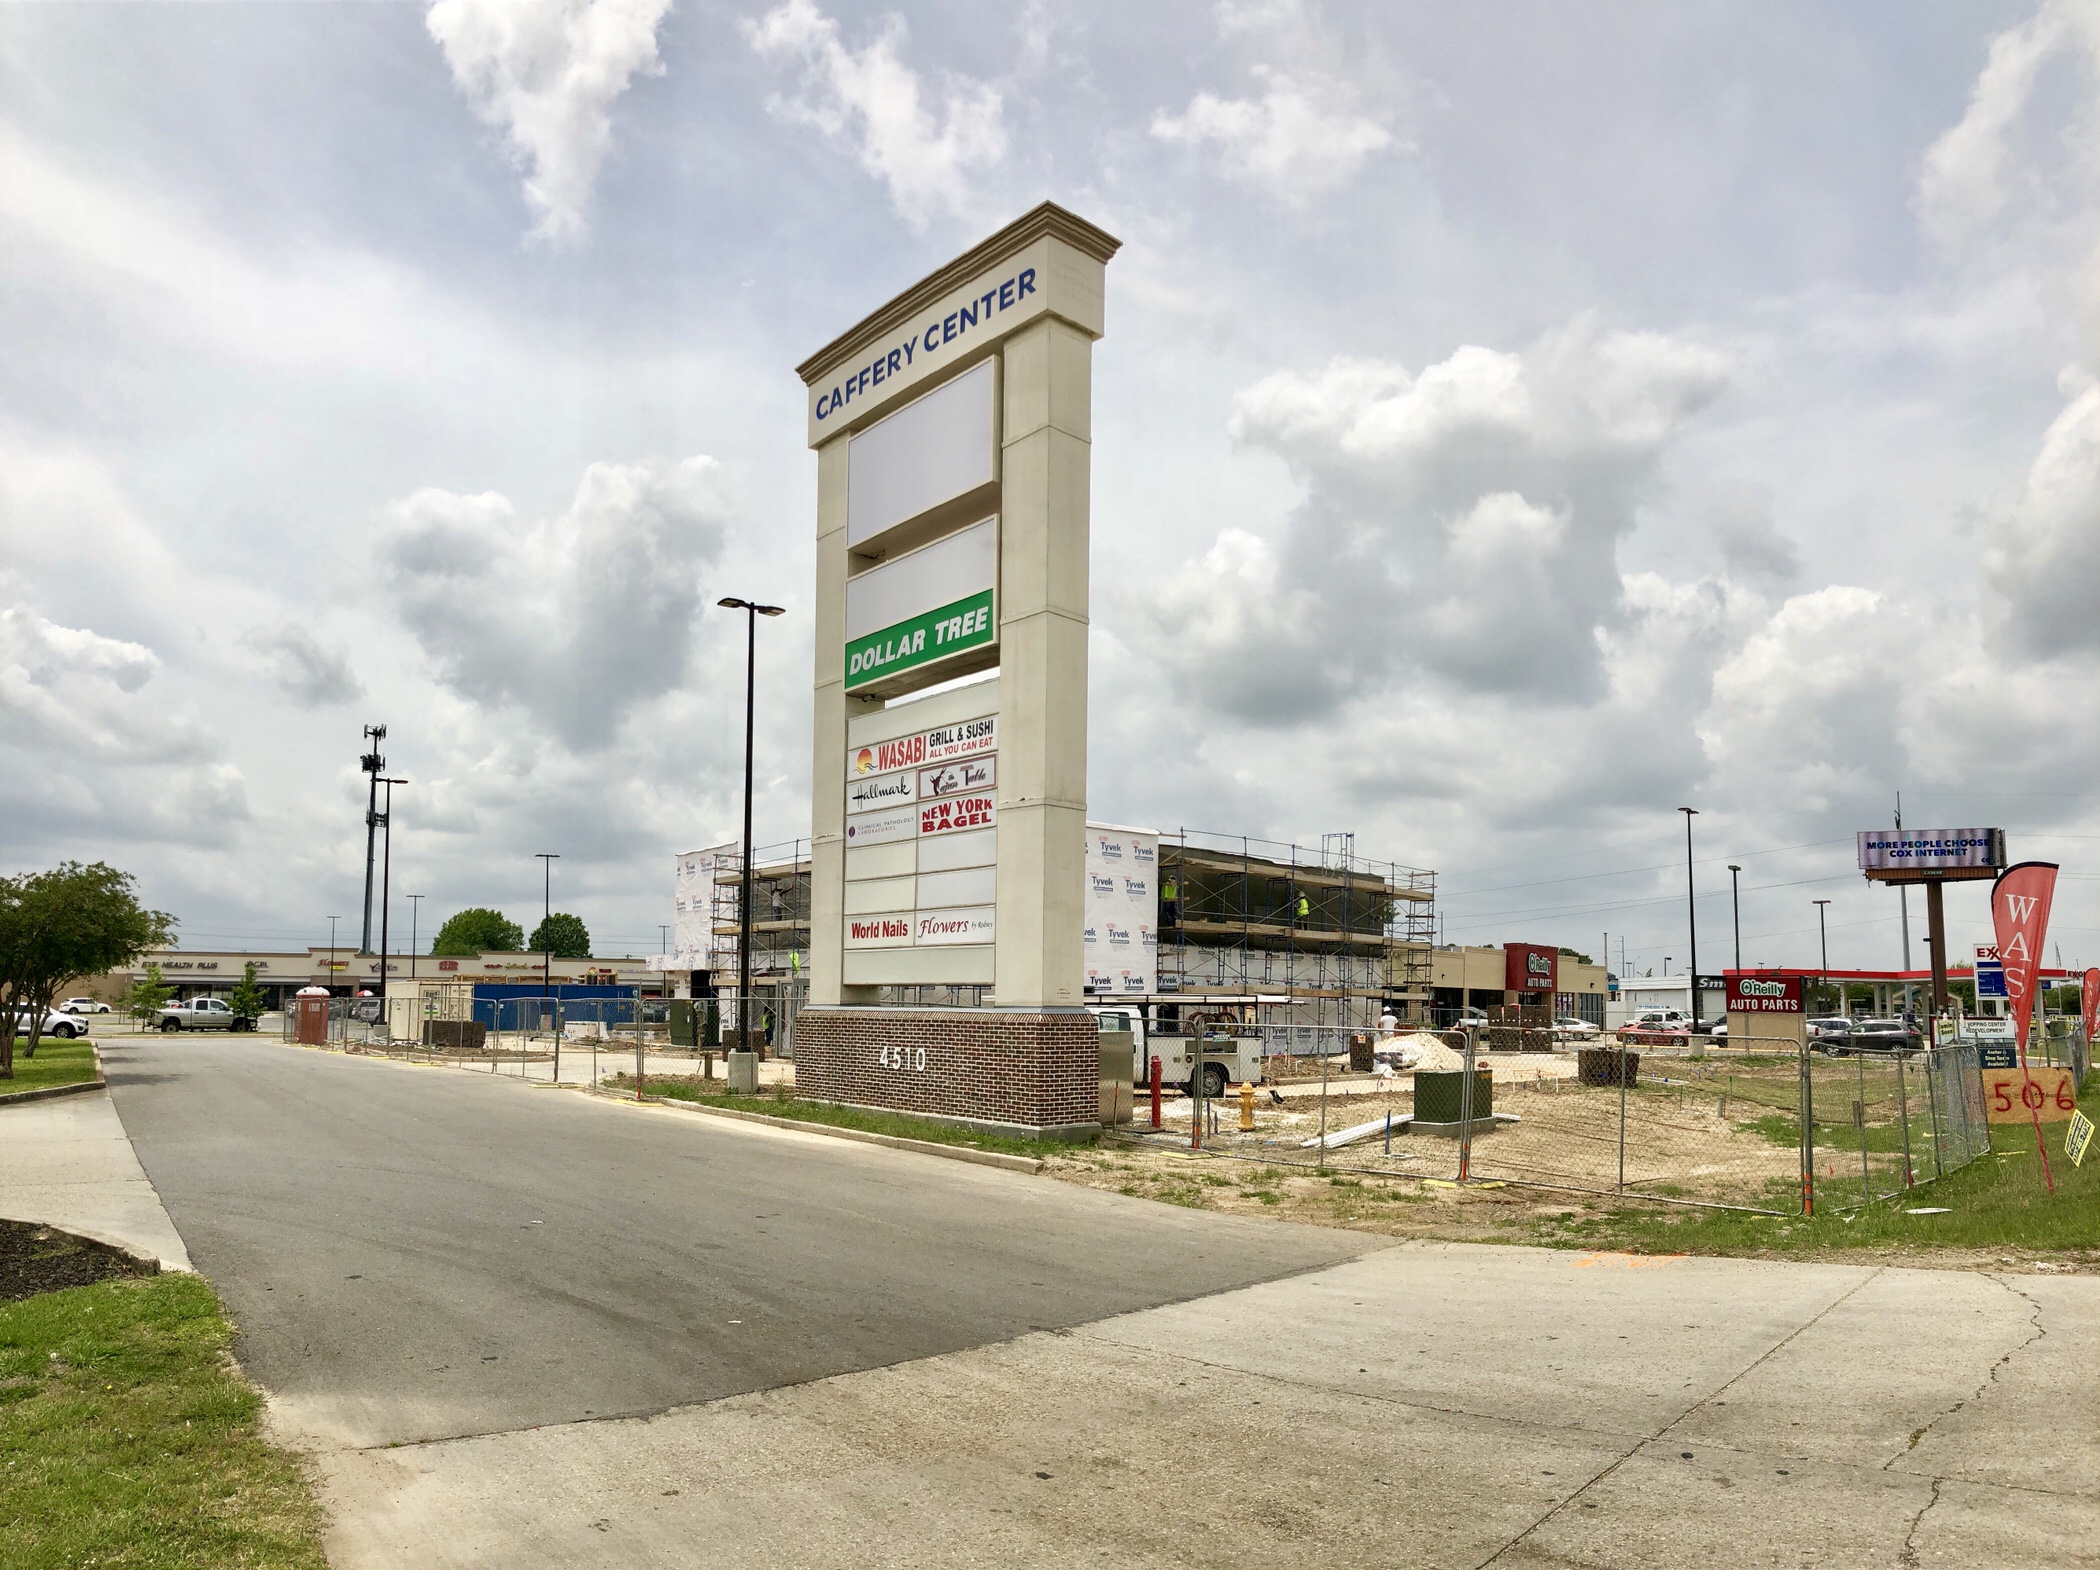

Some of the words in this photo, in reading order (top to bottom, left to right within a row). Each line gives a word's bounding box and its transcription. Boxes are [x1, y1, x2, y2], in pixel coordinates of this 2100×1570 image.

[816, 336, 918, 420] CAFFERY
[923, 268, 1036, 352] CENTER
[849, 629, 926, 676] DOLLAR
[935, 605, 989, 645] TREE
[929, 729, 954, 747] GRILL
[957, 727, 963, 741] &
[966, 719, 994, 739] SUSHI
[878, 735, 926, 771] WASABI
[929, 748, 942, 759] ALL
[944, 744, 959, 756] YOU
[961, 740, 977, 753] CAN
[979, 737, 993, 748] EAT
[960, 764, 986, 786] Table
[852, 776, 912, 810] Hallmark
[922, 802, 951, 821] NEW
[956, 799, 993, 815] YORK
[858, 822, 882, 831] CLINICAL
[884, 817, 914, 826] PATHOLOGY
[922, 812, 992, 833] BAGEL
[858, 825, 896, 836] LABORATORIES
[1101, 841, 1121, 852] Tyvek
[1133, 846, 1154, 856] Tyvek
[1867, 841, 1898, 850] MORE
[1901, 840, 1941, 849] PEOPLE
[1944, 838, 1990, 848] CHOOSE
[1889, 850, 1912, 858] COX
[1915, 848, 1967, 857] INTERNET
[1092, 876, 1113, 886] Tyvek
[1125, 879, 1145, 889] Tyvek
[852, 921, 879, 939] World
[882, 920, 908, 938] Nails
[918, 917, 969, 938] Flowers
[1109, 929, 1129, 939] Tyvek
[1141, 931, 1157, 940] Tyve
[1977, 946, 2000, 960] EXX
[162, 961, 193, 969] HEALTH
[1090, 976, 1112, 986] Tyvek
[1123, 976, 1144, 986] Tyvek
[1698, 978, 1726, 988] Sm
[1741, 979, 1786, 997] O'Reilly
[1730, 999, 1758, 1010] AUTO
[1762, 999, 1798, 1010] PARTS
[880, 1046, 926, 1072] 4510
